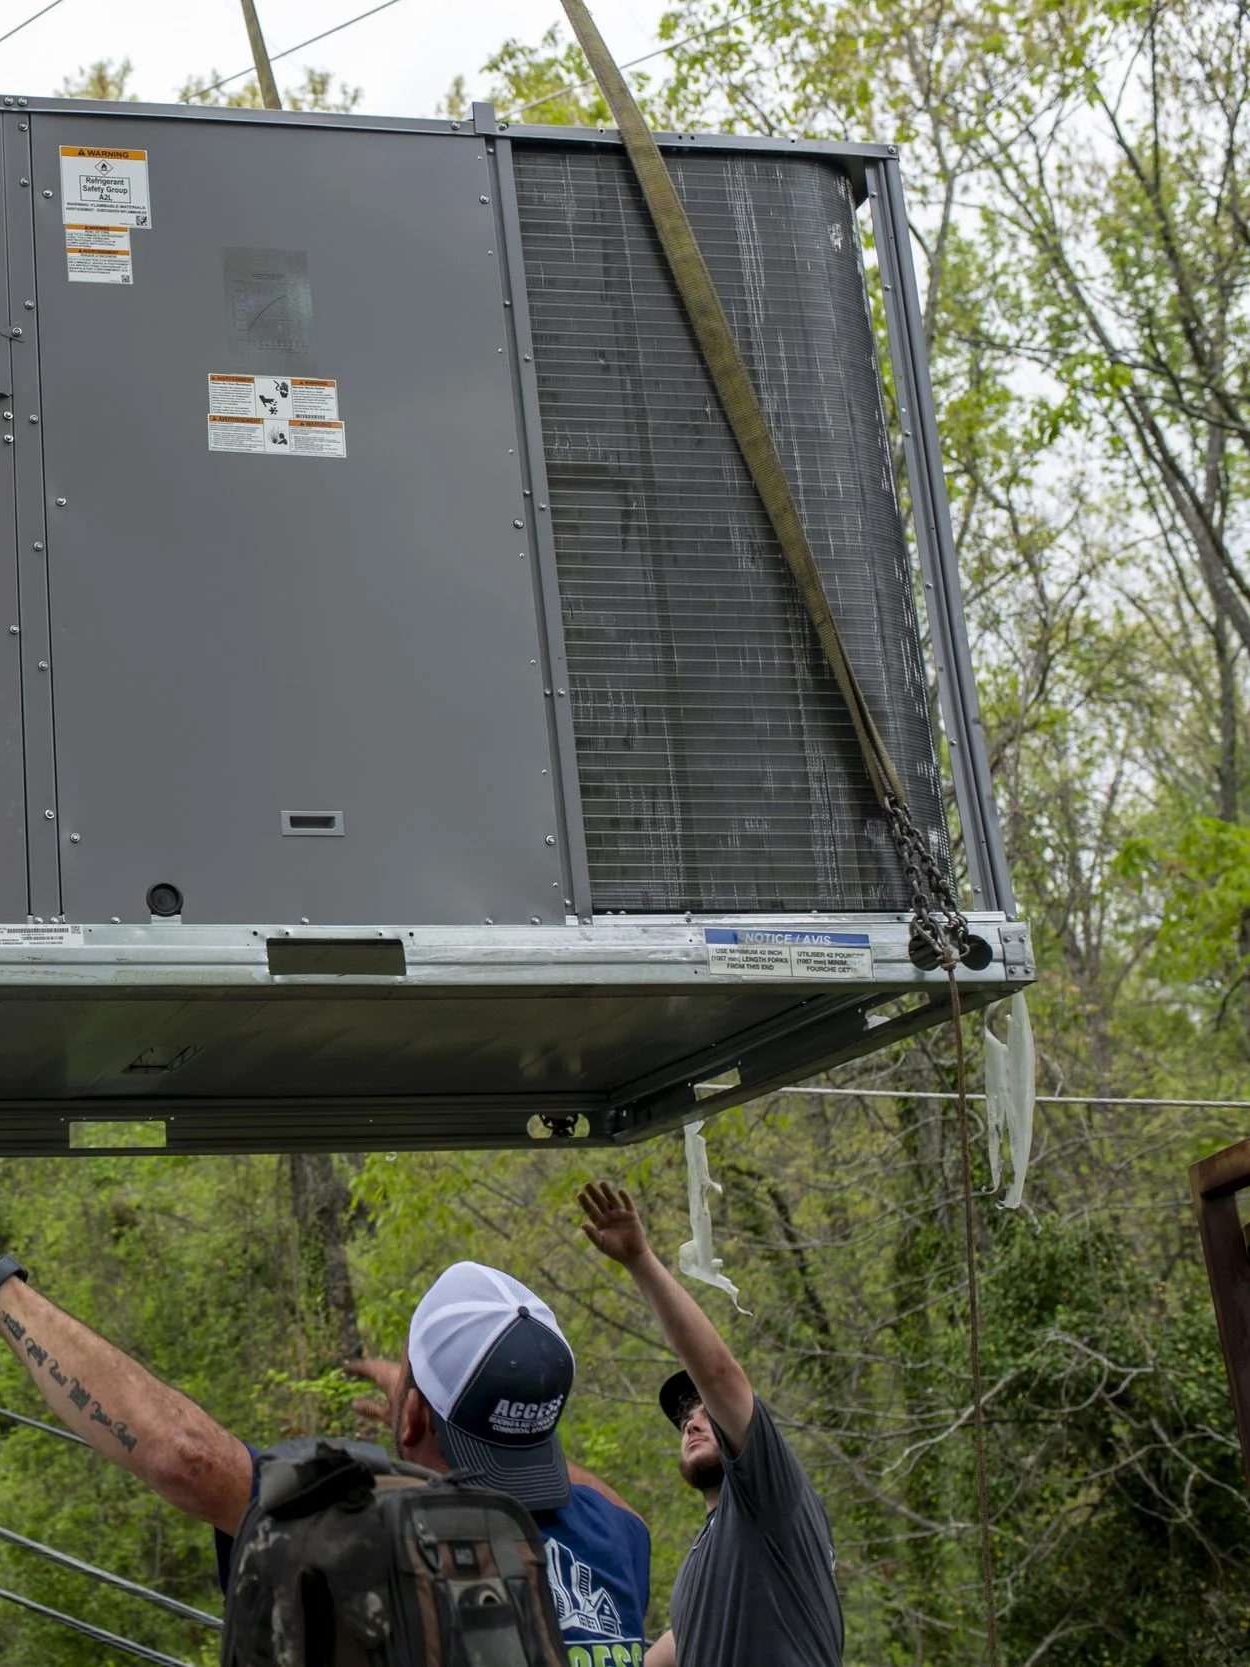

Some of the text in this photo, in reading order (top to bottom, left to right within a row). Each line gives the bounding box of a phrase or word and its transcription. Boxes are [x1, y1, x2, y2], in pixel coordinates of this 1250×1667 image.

[87, 150, 129, 159] WARNING
[85, 177, 125, 186] Refrigerant
[82, 185, 128, 195] Safety Group
[746, 932, 792, 944] NOTICE
[803, 935, 831, 944] AVIS
